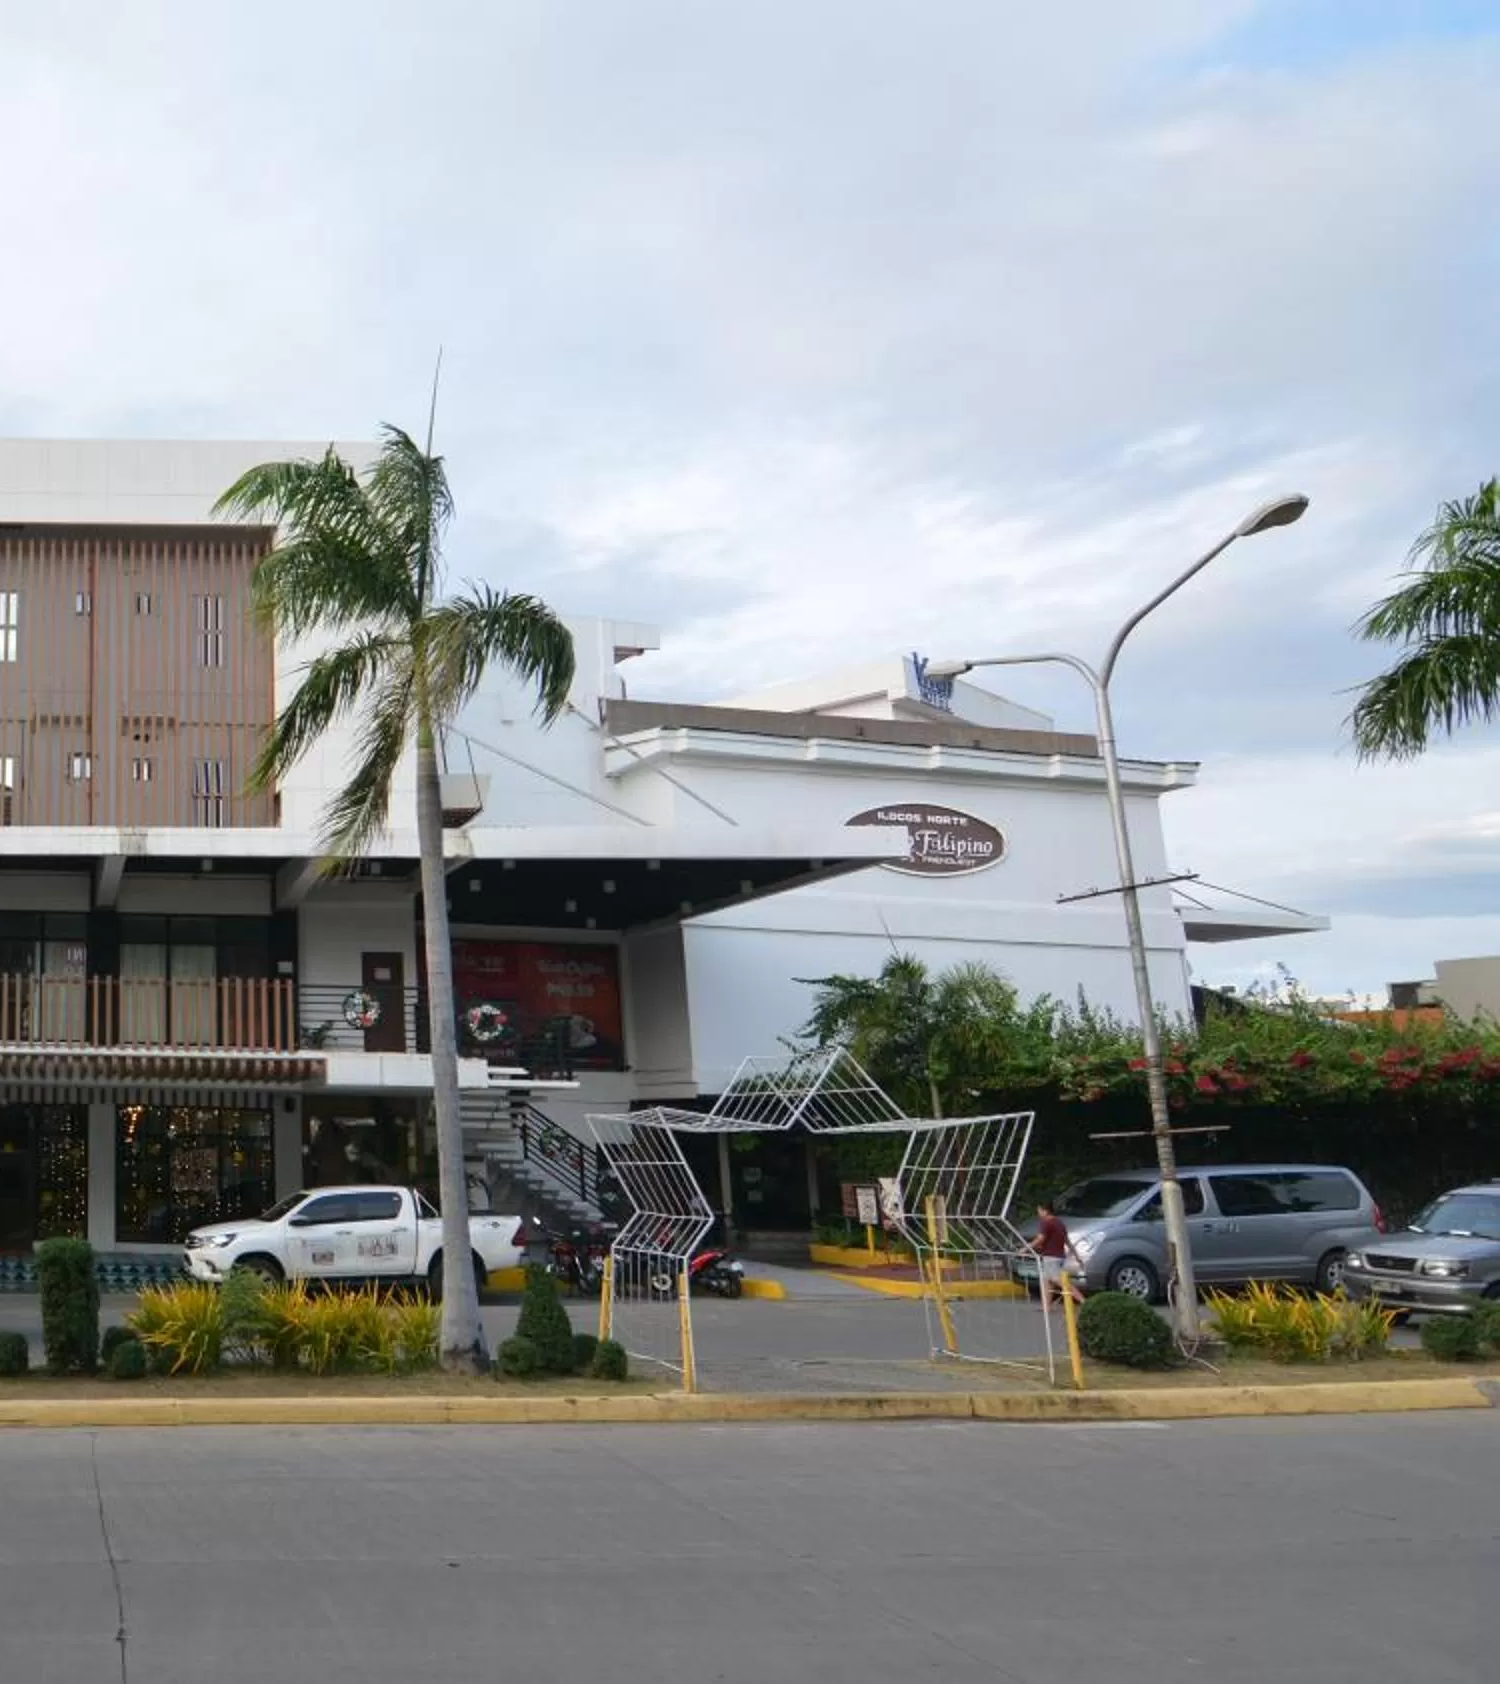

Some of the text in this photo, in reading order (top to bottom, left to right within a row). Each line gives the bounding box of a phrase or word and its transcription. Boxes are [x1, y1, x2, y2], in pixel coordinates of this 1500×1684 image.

[877, 811, 969, 826] ILOCOS NORTE
[915, 829, 993, 857] Filipino
